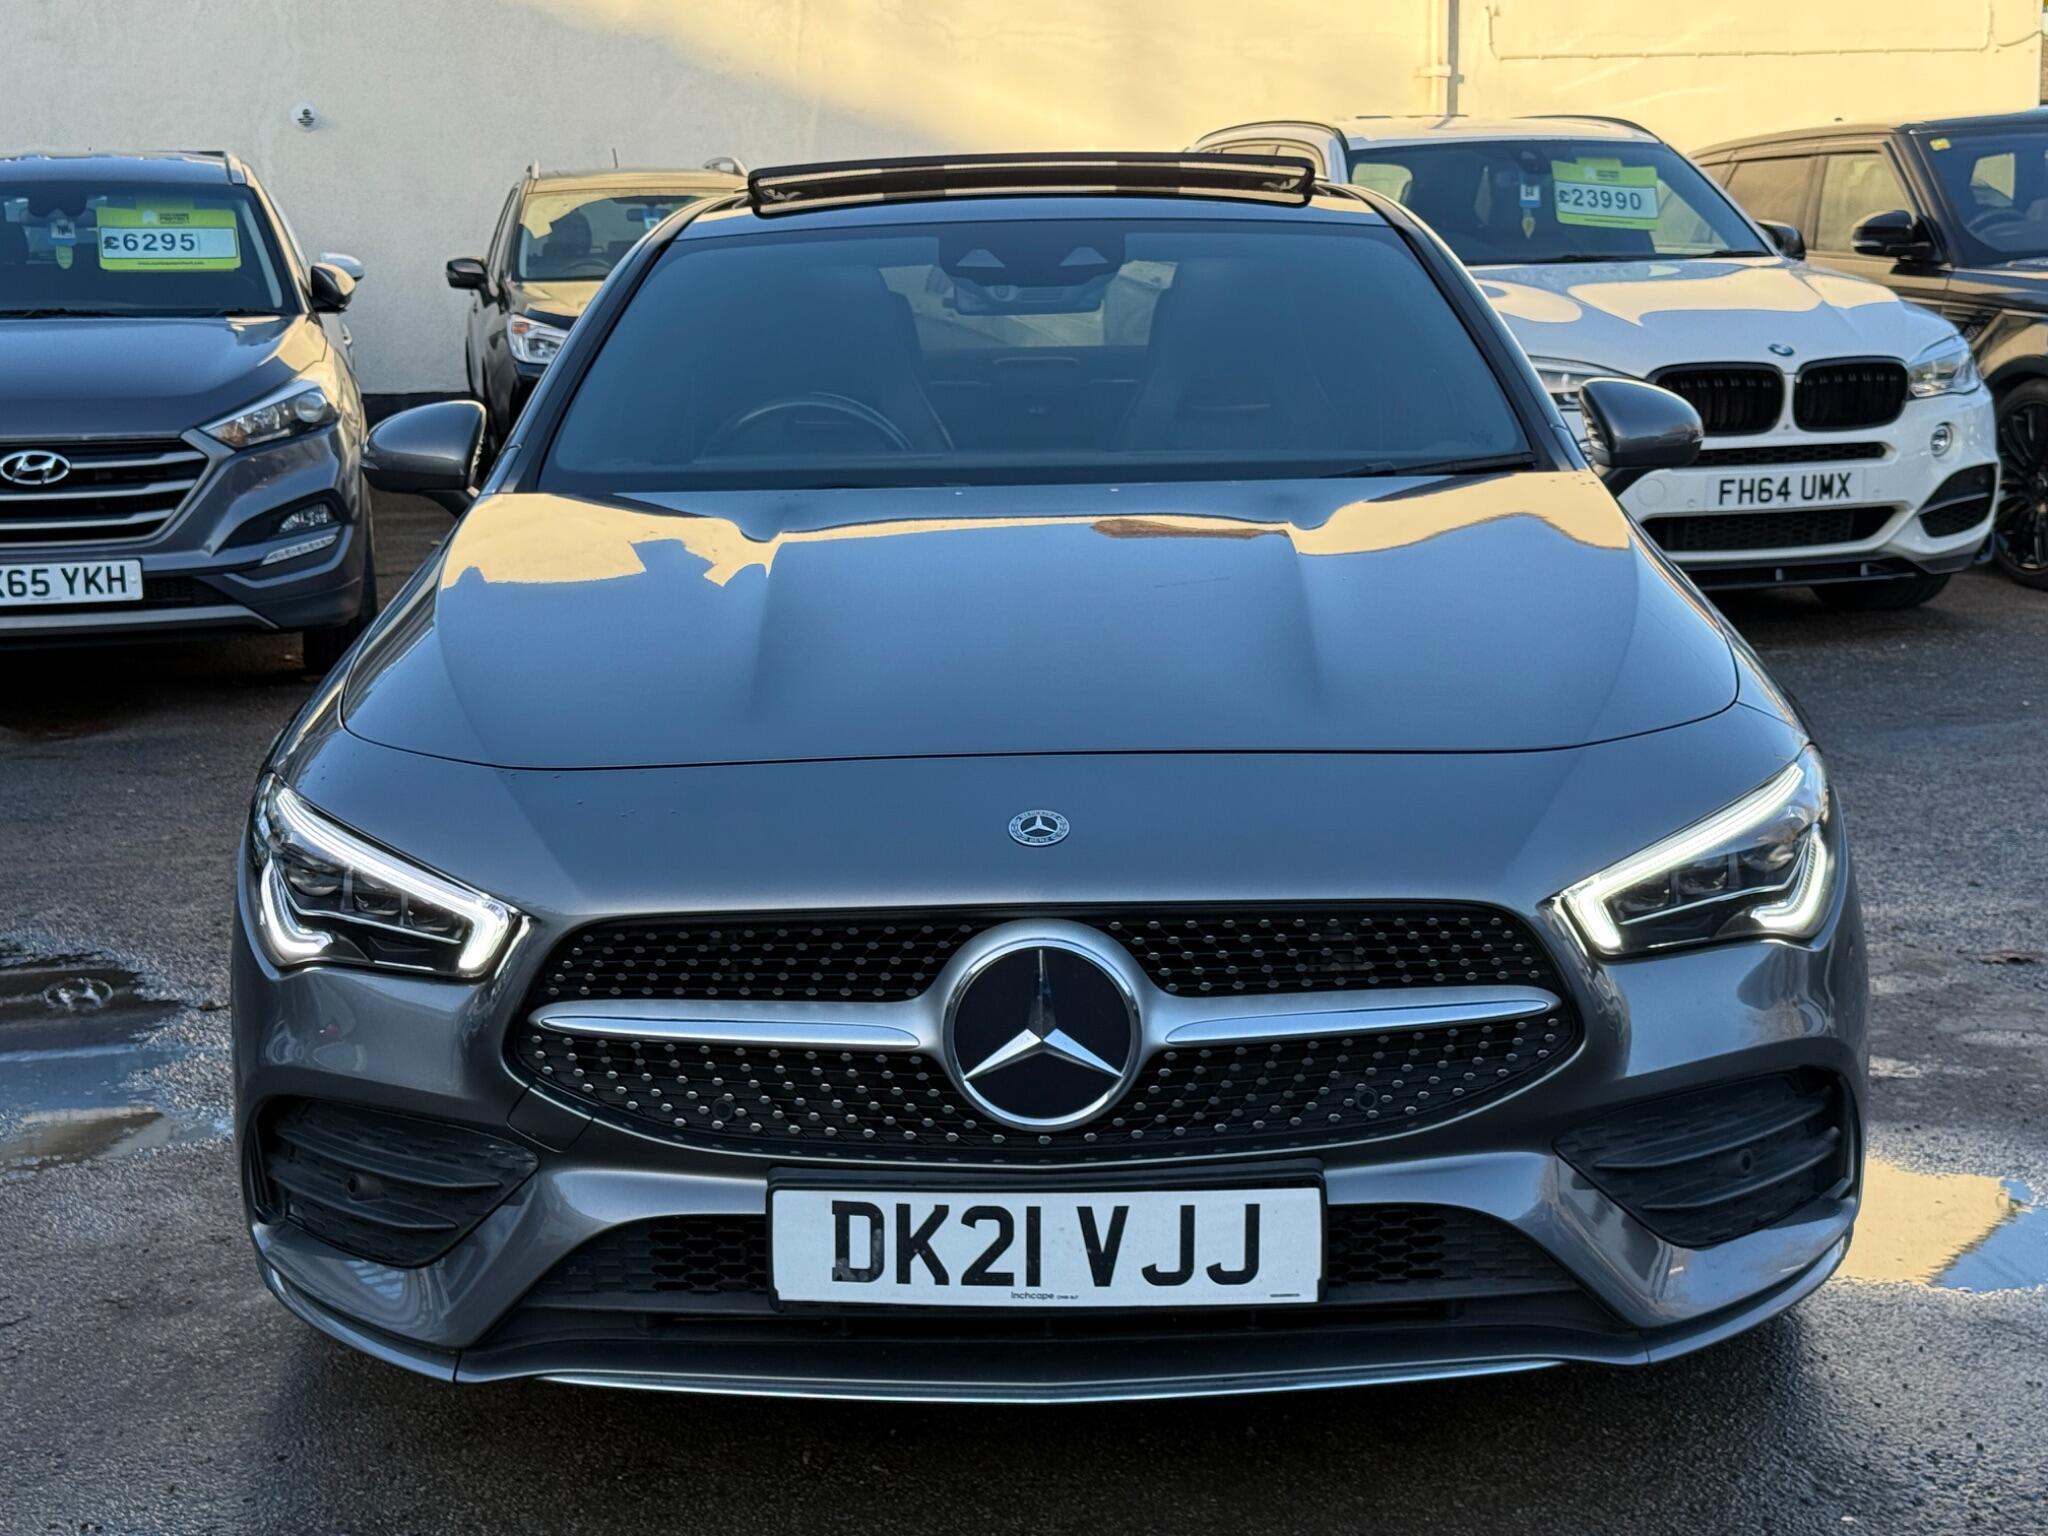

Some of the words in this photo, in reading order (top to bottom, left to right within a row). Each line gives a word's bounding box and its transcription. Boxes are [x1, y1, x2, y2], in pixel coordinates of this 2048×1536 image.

[1559, 188, 1641, 210] £23990
[103, 233, 195, 252] £6295
[1718, 476, 1791, 506] FH64
[1801, 472, 1851, 501] UMX
[61, 565, 127, 595] YKH
[831, 1200, 1041, 1287] DK21
[1076, 1203, 1260, 1287] VJJ
